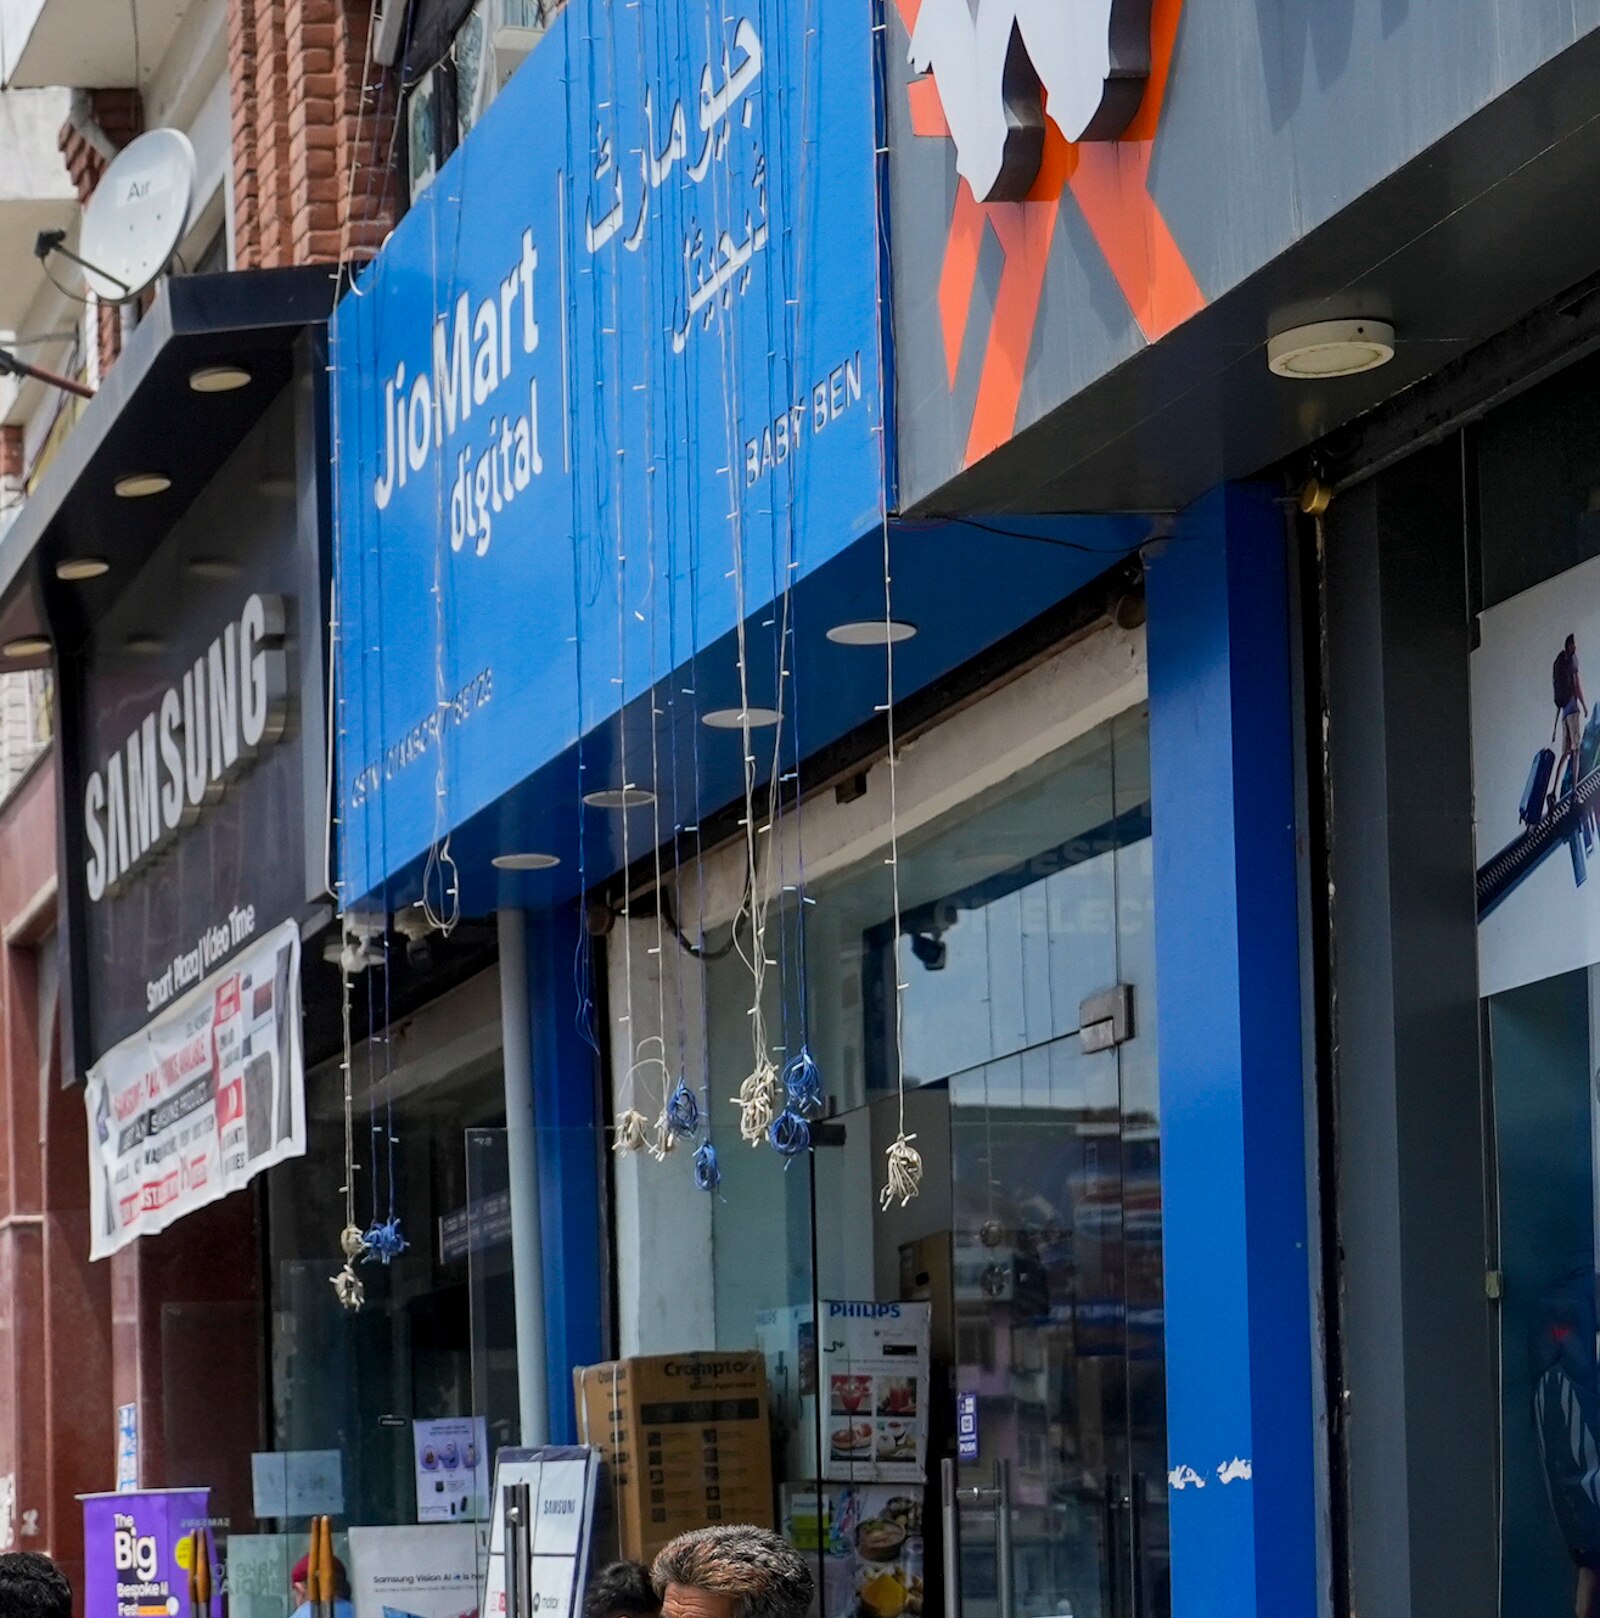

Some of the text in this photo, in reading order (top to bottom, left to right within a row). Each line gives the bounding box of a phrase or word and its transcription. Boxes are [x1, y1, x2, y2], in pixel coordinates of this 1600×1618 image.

[374, 224, 542, 511] JioMart
[450, 379, 544, 557] digital
[85, 593, 286, 903] SAMSUNG
[146, 964, 173, 1012] Smart
[229, 903, 256, 949] Time
[829, 1302, 901, 1319] PHILIPS
[113, 1513, 135, 1528] The
[543, 1499, 576, 1514] SAMSUNG
[114, 1527, 158, 1581] Big
[116, 1582, 160, 1600] Bespoke
[373, 1574, 414, 1585] Samsung
[416, 1574, 442, 1584] Vision
[444, 1574, 452, 1582] AI
